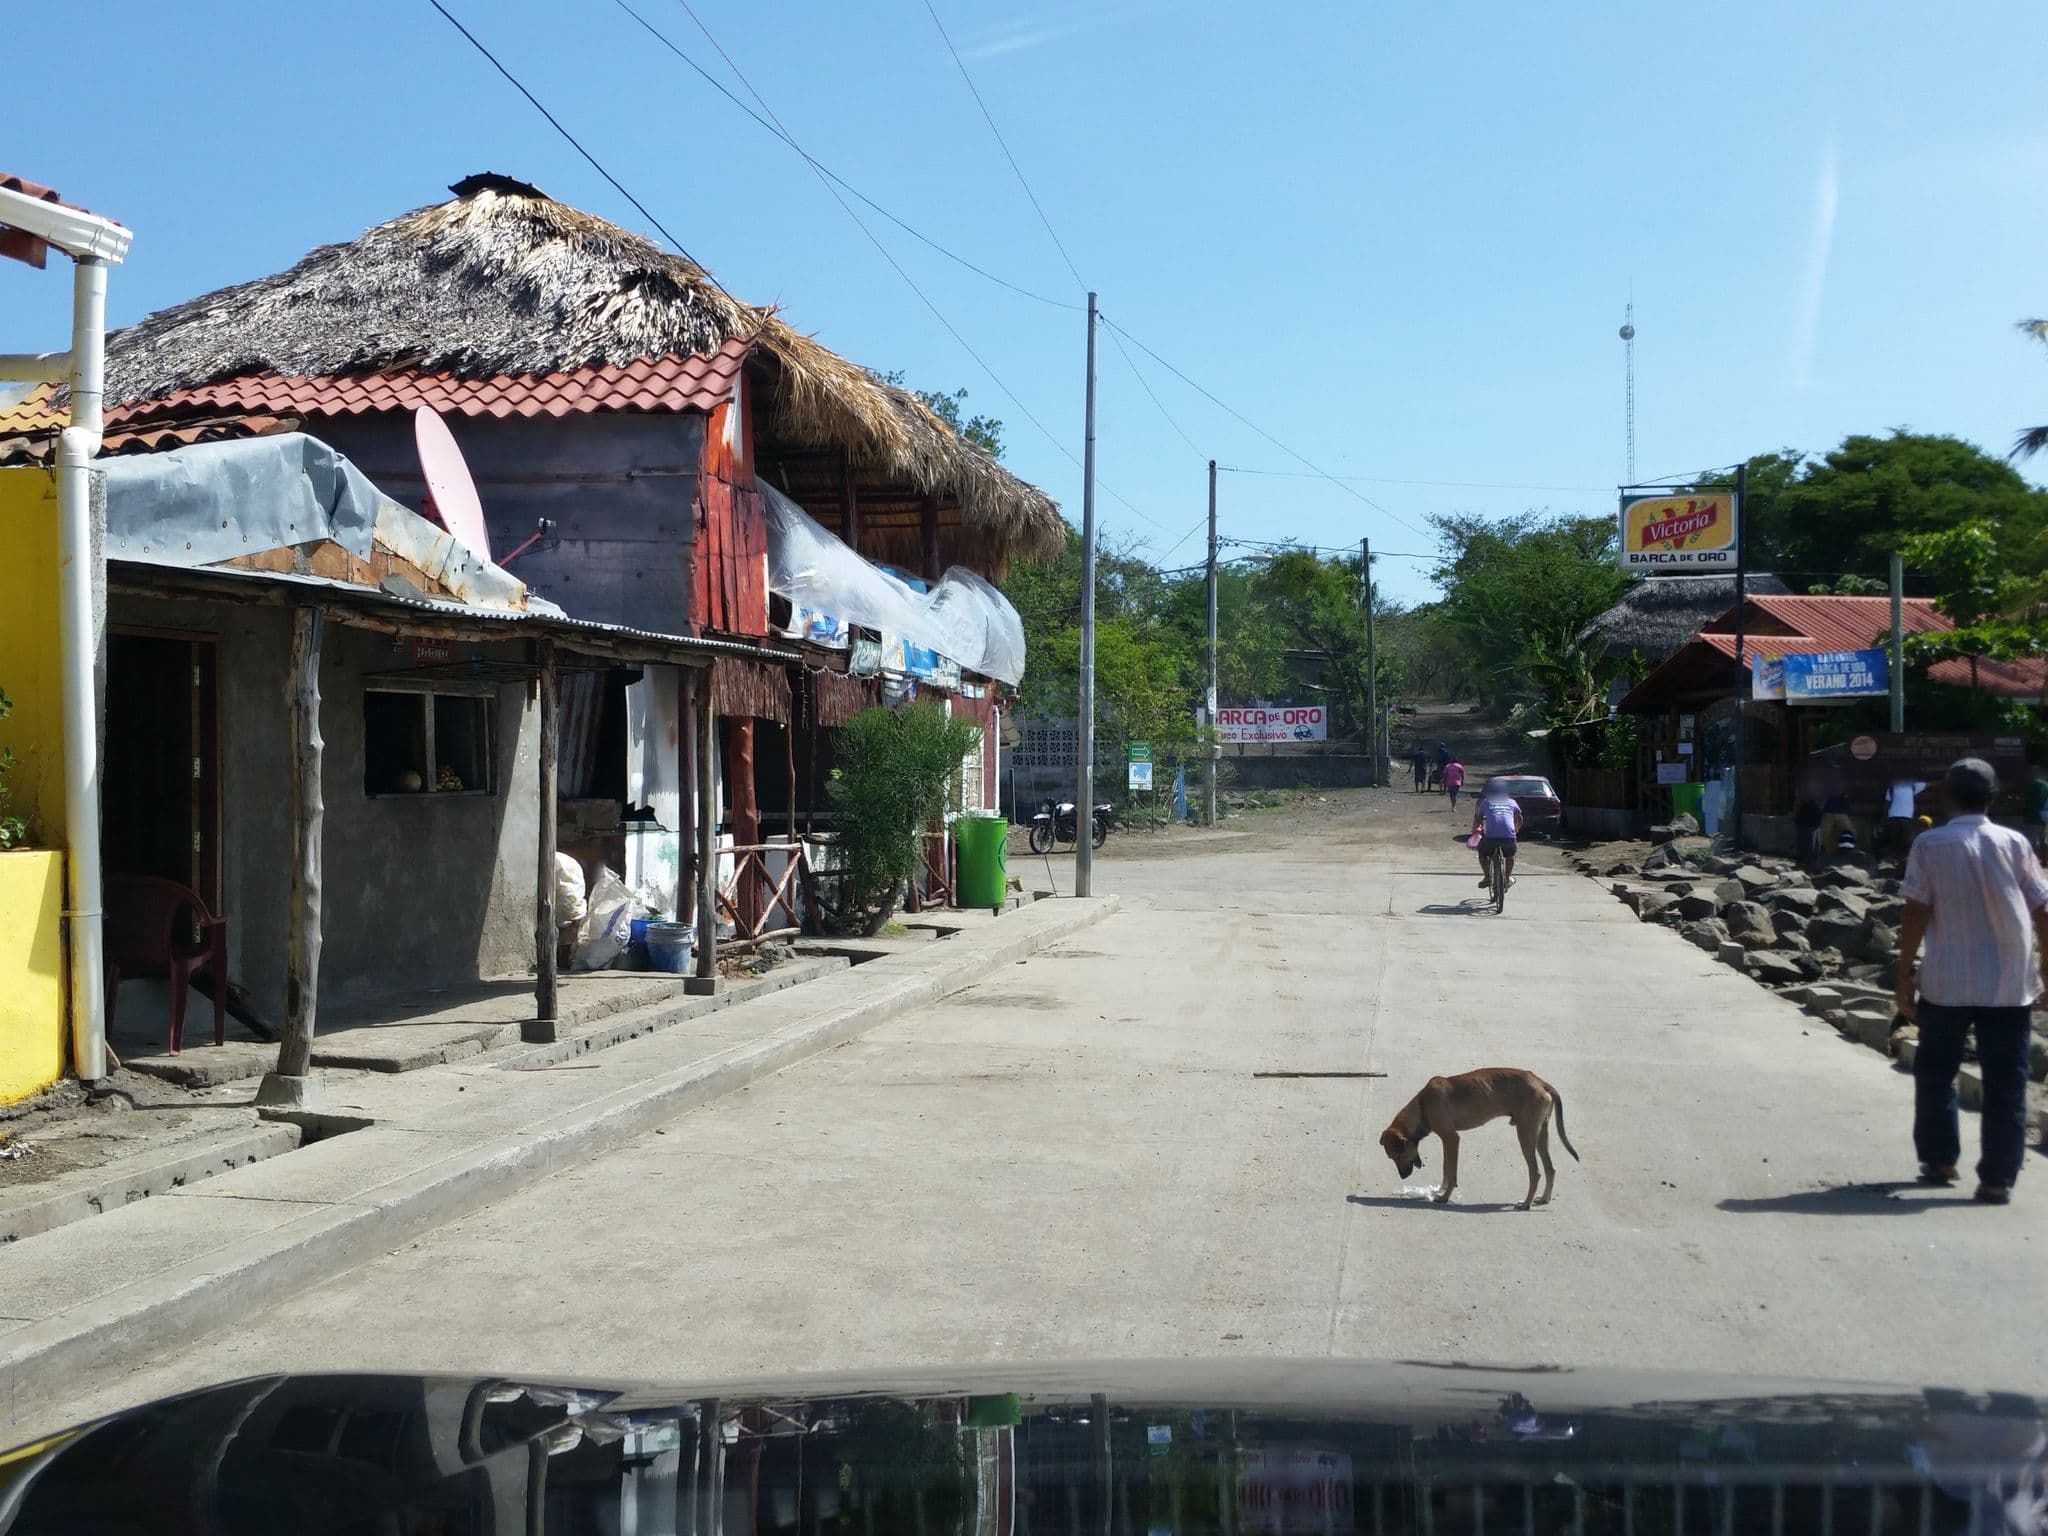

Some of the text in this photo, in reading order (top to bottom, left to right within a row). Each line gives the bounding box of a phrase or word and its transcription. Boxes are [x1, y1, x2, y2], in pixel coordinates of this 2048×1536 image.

[1650, 513, 1709, 541] Victoria
[1630, 553, 1677, 563] BARCA
[1698, 552, 1727, 562] ORO
[1806, 672, 1874, 689] VERANO 2014
[1216, 708, 1322, 725] ARCA DE ORO
[1241, 728, 1287, 740] Exclusivo
